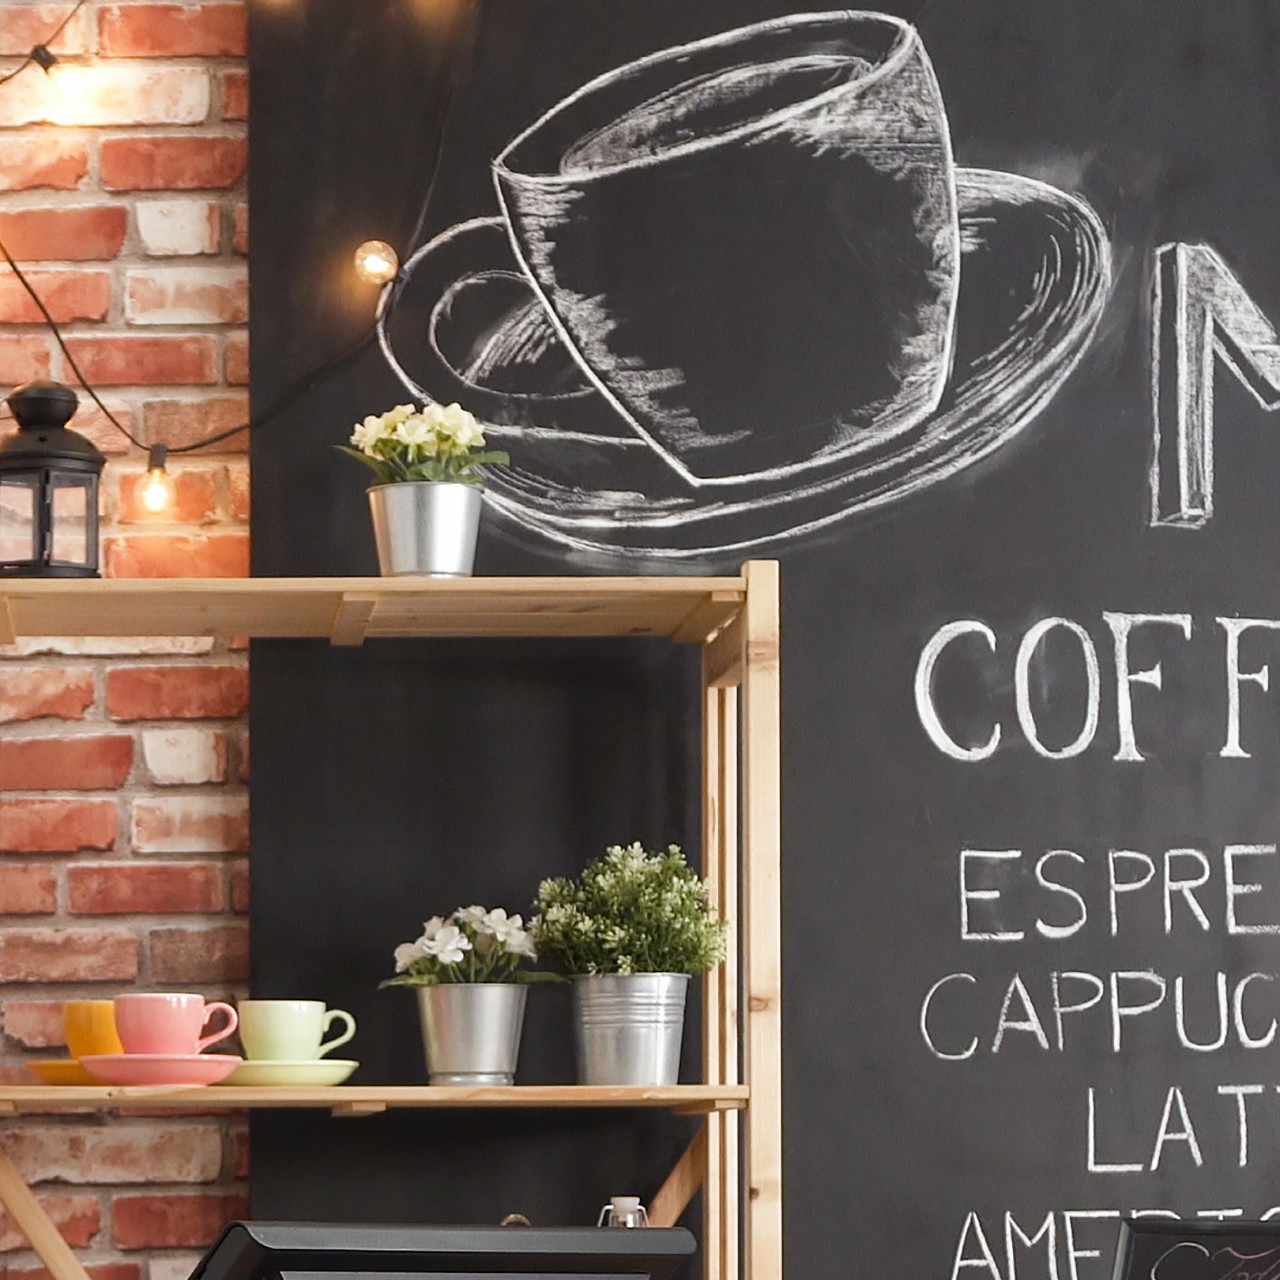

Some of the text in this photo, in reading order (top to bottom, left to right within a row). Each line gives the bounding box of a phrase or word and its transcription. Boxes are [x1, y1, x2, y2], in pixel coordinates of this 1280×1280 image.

[914, 611, 1280, 762] COFF
[960, 845, 1280, 939] ESPRE
[920, 971, 1280, 1060] CAPPUC
[1086, 1086, 1280, 1172] LAT
